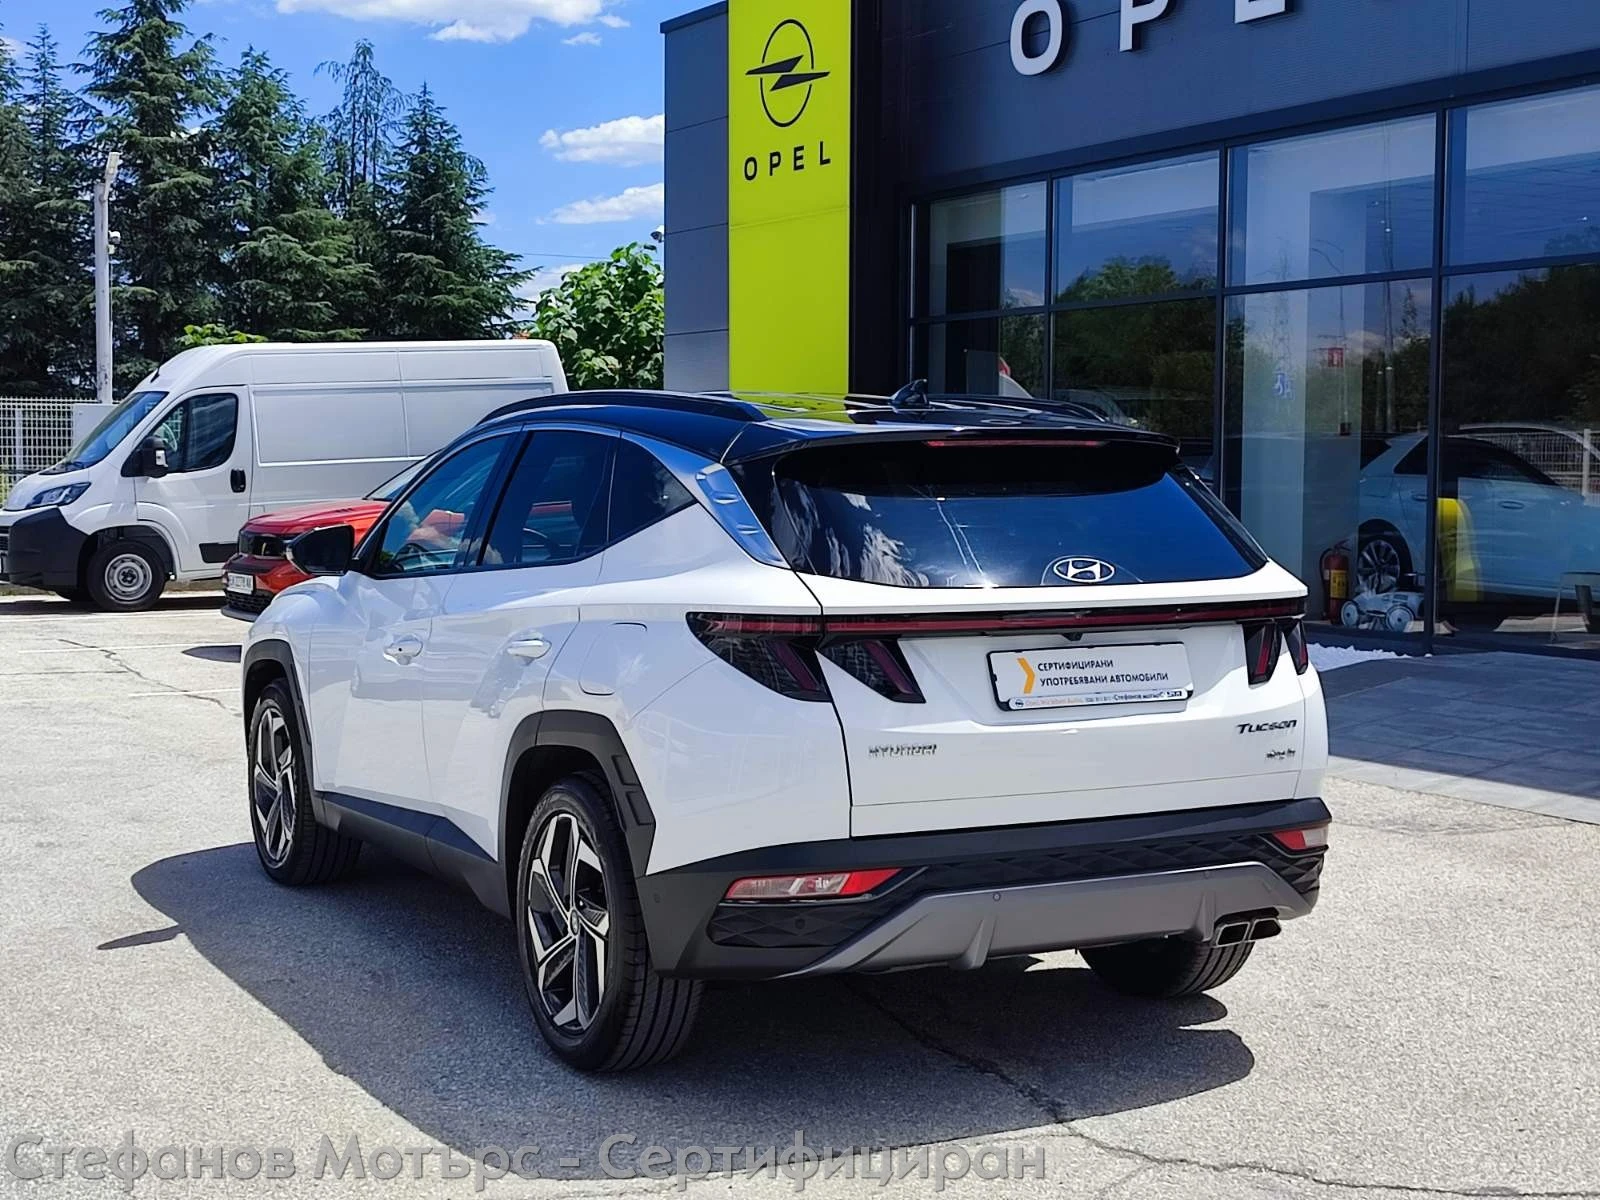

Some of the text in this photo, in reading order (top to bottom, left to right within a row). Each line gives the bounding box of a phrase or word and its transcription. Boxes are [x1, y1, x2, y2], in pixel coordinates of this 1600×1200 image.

[1009, 0, 1287, 76] OP
[744, 141, 831, 181] OPEL
[1038, 660, 1114, 671] СЕРТИФИЦИРАНИ
[1040, 673, 1169, 687] УПОТРЕБЯВАНИ АВТОМОБИЛИ
